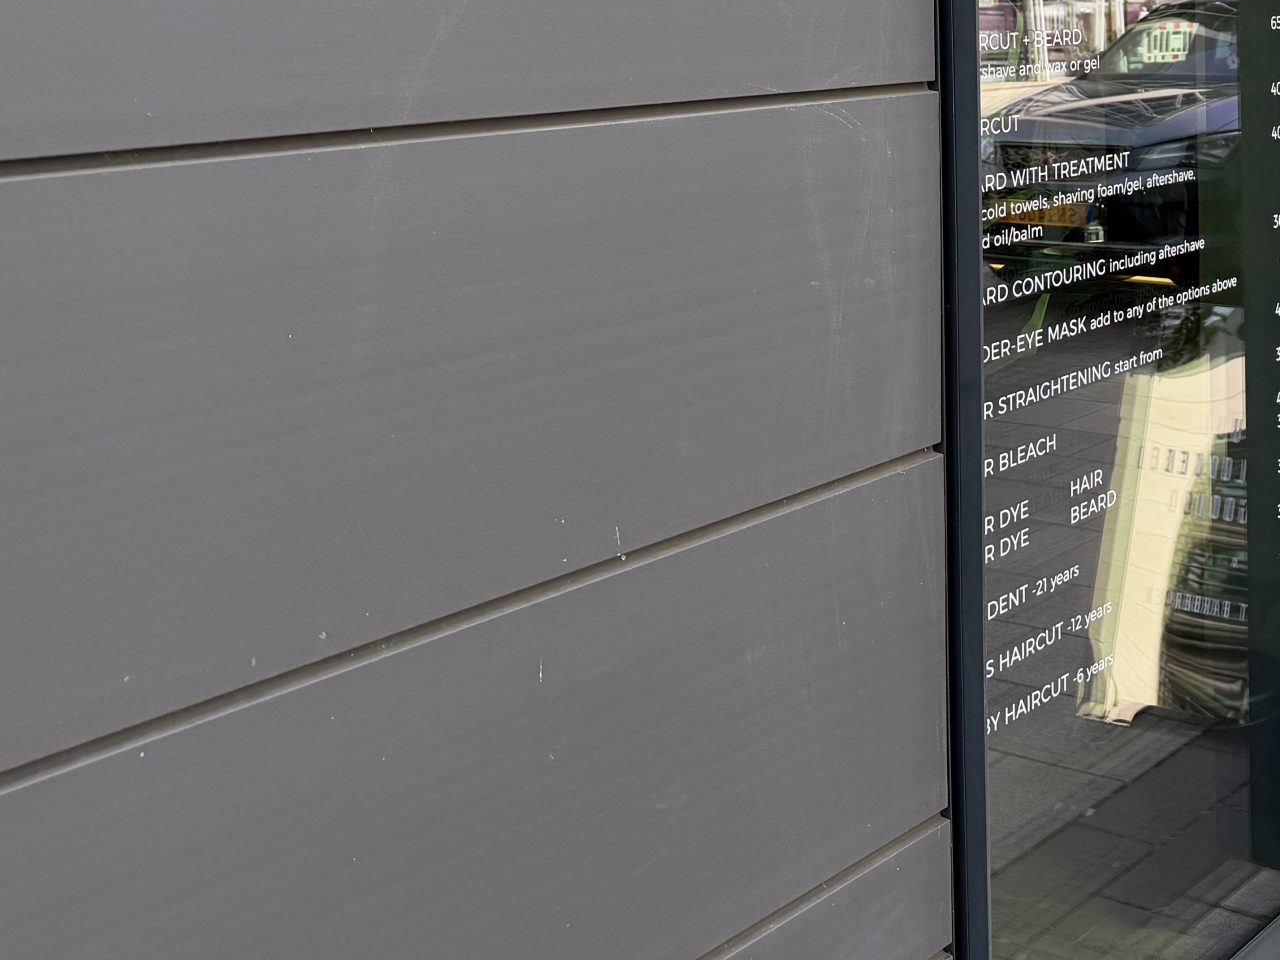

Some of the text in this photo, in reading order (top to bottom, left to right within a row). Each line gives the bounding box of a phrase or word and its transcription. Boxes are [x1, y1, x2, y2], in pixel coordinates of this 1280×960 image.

[979, 28, 1082, 52] RCUT + BEARD
[1019, 58, 1041, 76] and
[1044, 60, 1068, 74] wax
[1069, 58, 1081, 72] or
[1083, 54, 1100, 74] gel
[980, 114, 1020, 136] RCUT
[1010, 164, 1049, 189] WITH
[1051, 151, 1131, 180] TREATMENT
[1010, 194, 1051, 216] towels,
[1052, 187, 1095, 207] shaving
[1097, 176, 1145, 198] foam/gel,
[1146, 168, 1196, 189] aftershave,
[981, 224, 1044, 250] d oil/balm
[1012, 259, 1106, 298] CONTOURING
[1109, 250, 1157, 273] including
[1158, 238, 1206, 261] aftershave
[1047, 315, 1087, 343] MASK
[1090, 310, 1111, 330] add
[1113, 310, 1124, 323] to
[1126, 303, 1145, 319] any
[1146, 296, 1157, 313] of
[1158, 294, 1175, 310] the
[1175, 285, 1211, 306] options
[1211, 276, 1238, 294] above
[983, 348, 1163, 420] R STRAIGHTENING start from
[983, 433, 1057, 478] R BLEACH
[1070, 469, 1103, 498] HAIR
[984, 499, 1030, 536] R DYE
[1070, 489, 1117, 525] BEARD
[984, 527, 1030, 564] R DYE
[987, 564, 1080, 620] DENT -21 years
[985, 601, 1112, 678] S HAIRCUT -12 years
[1005, 672, 1070, 725] HAIRCUT
[1072, 667, 1084, 683] -6
[1086, 654, 1114, 682] years
